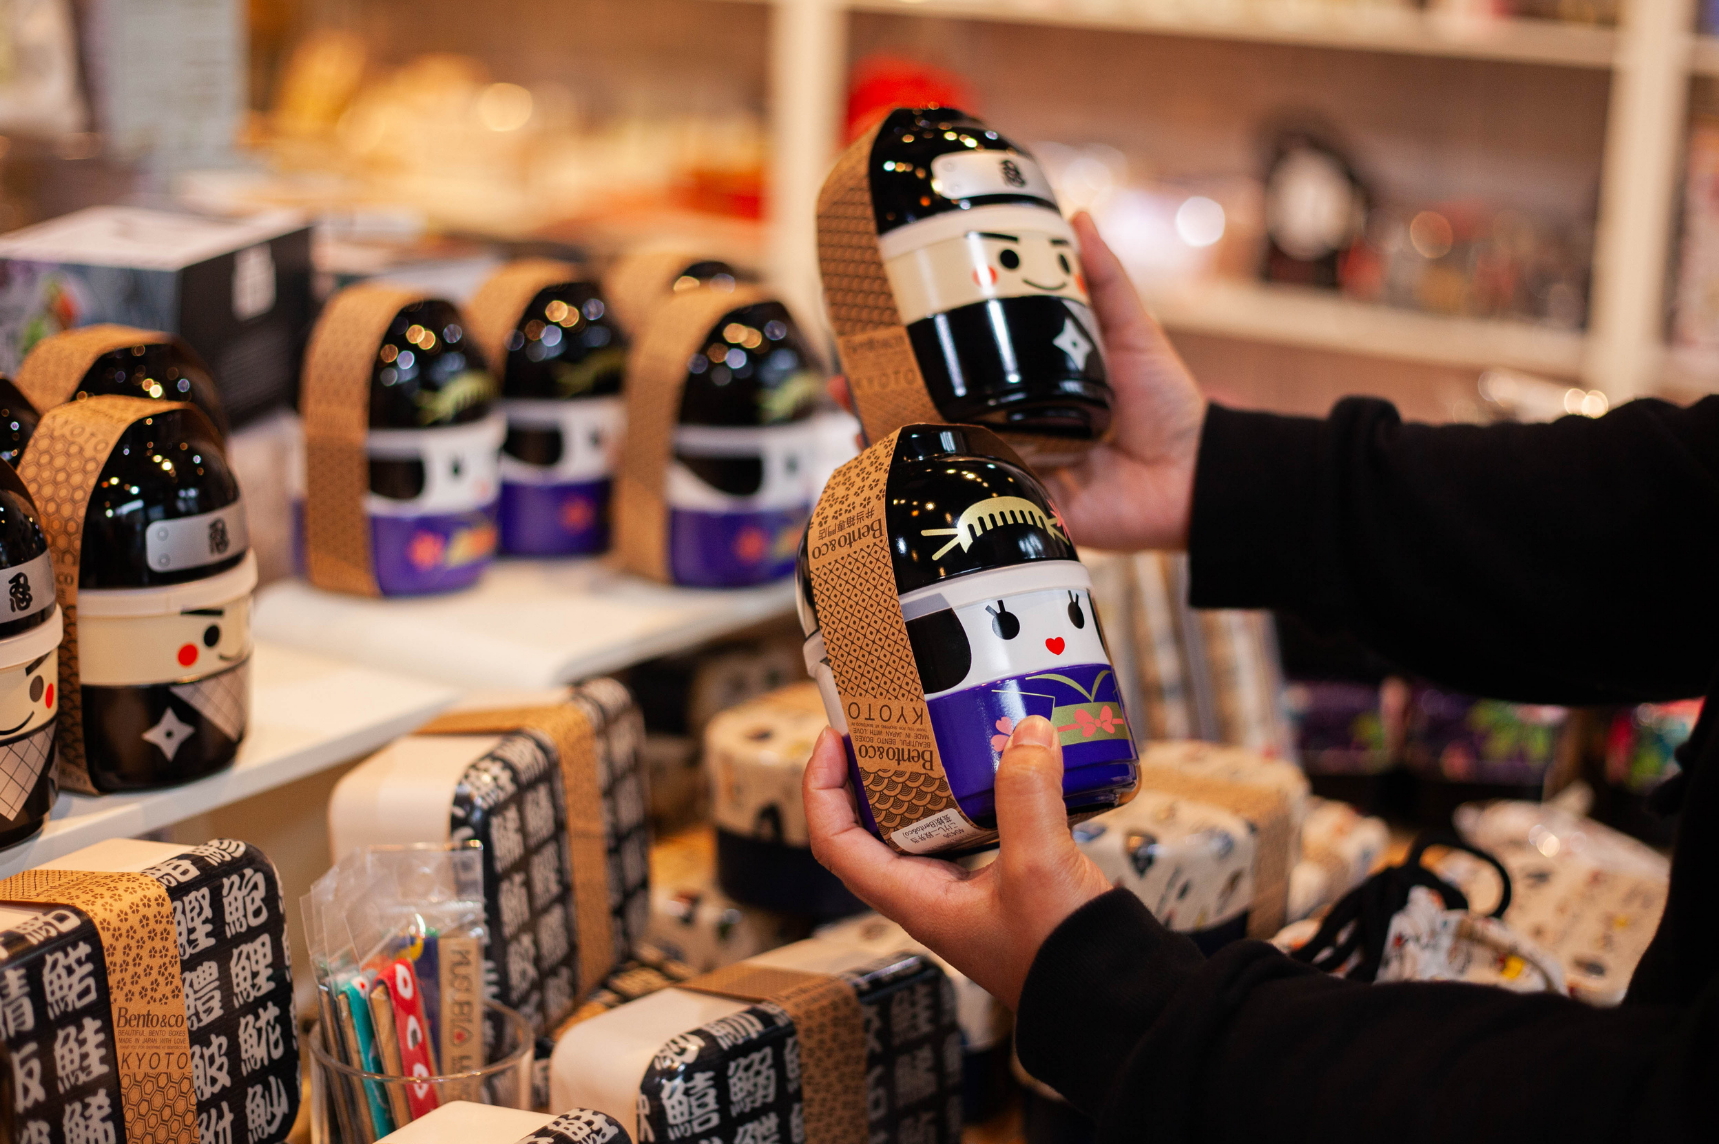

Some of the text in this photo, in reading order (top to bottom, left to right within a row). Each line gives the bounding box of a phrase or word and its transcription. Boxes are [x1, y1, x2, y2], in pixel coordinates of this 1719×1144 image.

[812, 518, 885, 560] Bento&co
[8, 571, 34, 613] 忍
[848, 701, 924, 726] KYOTO
[854, 735, 931, 748] BEAUTIFUL BENTO BOXES
[886, 730, 903, 738] JAPAN
[914, 732, 930, 740] MADE
[858, 744, 934, 771] Bento&co
[116, 1006, 184, 1028] Bento&co
[54, 1016, 110, 1094] 鮭
[121, 1052, 188, 1070] KYOTO
